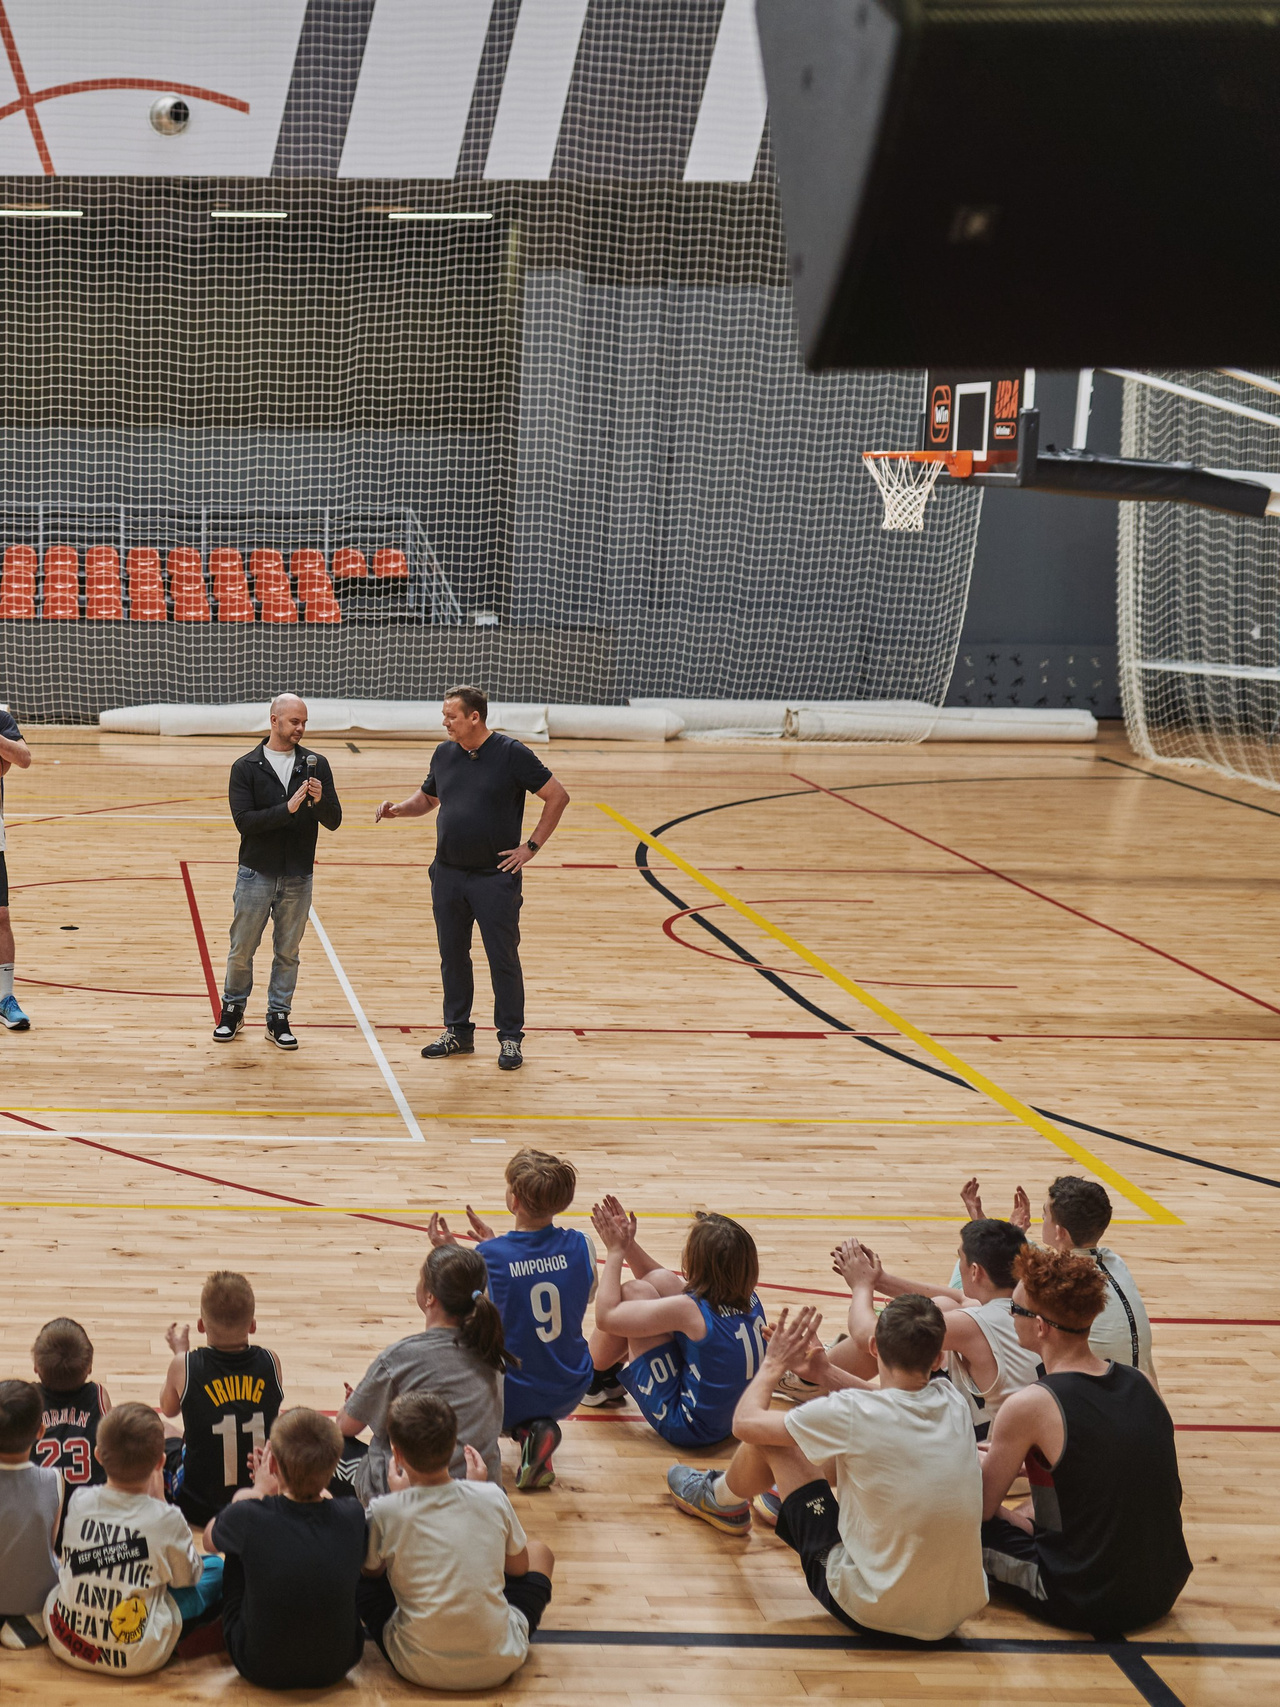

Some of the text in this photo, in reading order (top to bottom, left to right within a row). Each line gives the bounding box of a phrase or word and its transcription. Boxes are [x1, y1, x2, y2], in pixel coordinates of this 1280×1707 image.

[935, 405, 948, 424] Win
[508, 1254, 569, 1279] МИРОНОВ
[529, 1281, 563, 1344] 9
[203, 1373, 266, 1408] IRVING
[35, 1436, 92, 1485] 23
[211, 1411, 266, 1487] 11
[78, 1552, 92, 1565] KEEP
[92, 1549, 102, 1560] ON
[75, 1582, 123, 1612] AND
